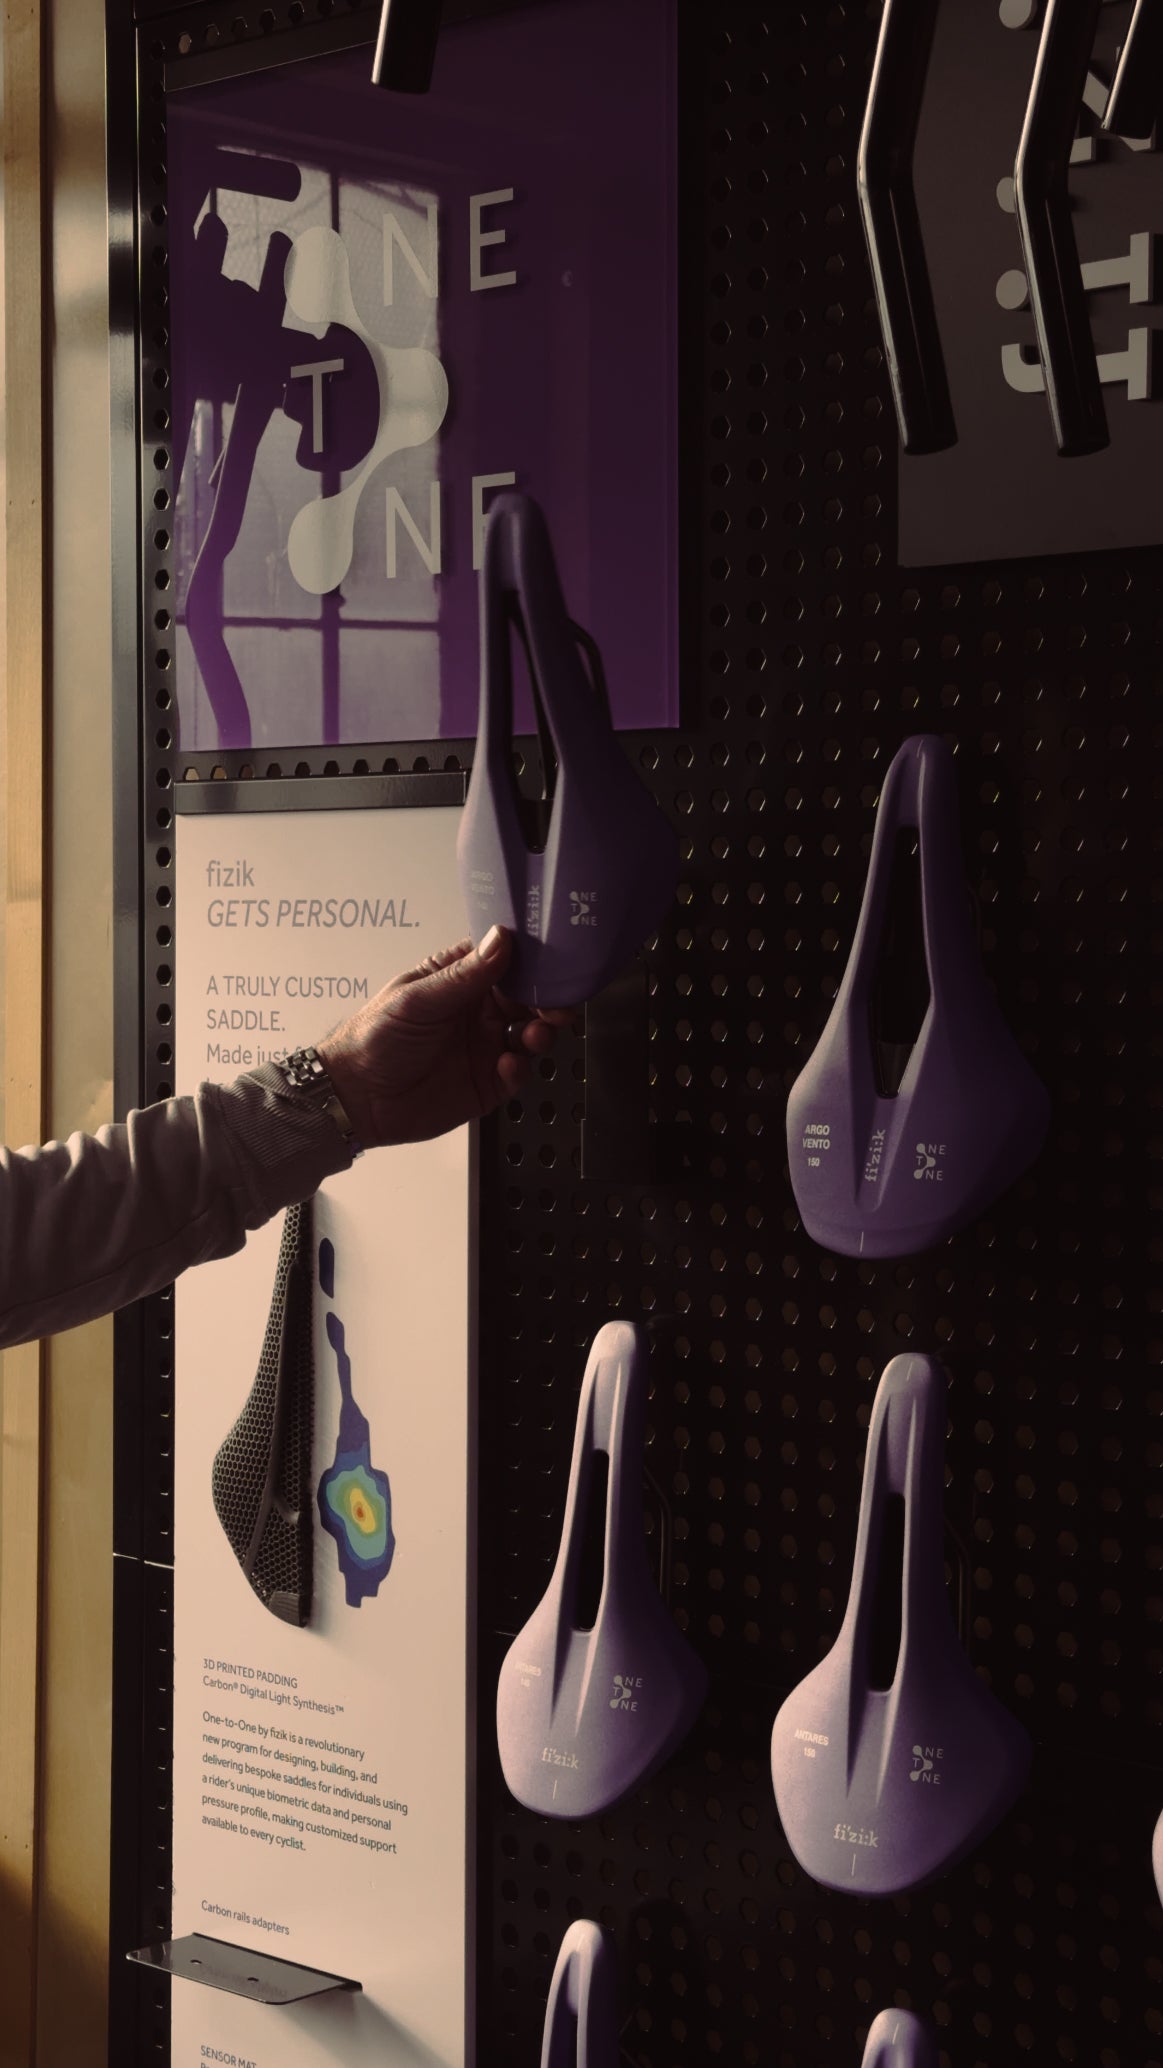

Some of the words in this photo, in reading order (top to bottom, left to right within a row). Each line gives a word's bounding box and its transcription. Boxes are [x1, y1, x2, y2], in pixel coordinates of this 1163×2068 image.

[206, 860, 255, 888] fizik
[207, 898, 270, 928] GETS
[276, 898, 421, 929] PERSONAL.
[206, 975, 219, 996] A
[222, 975, 281, 997] TRULY
[285, 976, 369, 999] CUSTOM
[207, 1008, 286, 1032] SADDLE.
[207, 1043, 253, 1065] Made
[802, 1138, 831, 1150] VENTO
[805, 1124, 830, 1135] ARGO
[203, 1658, 215, 1670] 3D
[216, 1661, 255, 1679] PRINTED
[256, 1670, 298, 1689] PADDING
[240, 1684, 268, 1701] Digital
[269, 1692, 291, 1706] Light
[202, 1711, 257, 1734] One-to-One
[258, 1723, 268, 1738] by
[270, 1726, 288, 1742] fizik
[289, 1733, 297, 1743] is
[298, 1735, 304, 1744] a
[305, 1737, 365, 1761] revolutionary
[794, 1729, 829, 1746] ANTARES
[202, 1734, 220, 1745] new
[221, 1738, 258, 1755] program
[259, 1745, 272, 1758] for
[273, 1749, 319, 1771] designing,
[320, 1760, 359, 1781] building,
[360, 1771, 378, 1784] and
[202, 1753, 243, 1774] delivering
[244, 1762, 282, 1781] bespoke
[283, 1774, 317, 1790] saddles
[318, 1781, 331, 1794] for
[333, 1784, 381, 1807] individuals
[383, 1799, 408, 1816] using
[202, 1774, 208, 1784] a
[236, 1783, 266, 1799] unique
[267, 1789, 310, 1809] biometric
[311, 1801, 332, 1815] data
[333, 1806, 350, 1820] and
[351, 1812, 392, 1831] personal
[202, 1794, 239, 1812] pressure
[240, 1803, 271, 1822] profile,
[272, 1812, 304, 1831] making
[305, 1821, 358, 1843] customized
[360, 1836, 397, 1854] support
[202, 1814, 238, 1832] available
[239, 1823, 249, 1835] to
[250, 1827, 275, 1845] every
[276, 1834, 307, 1851] cyclist.
[201, 1900, 232, 1918] Carbon
[233, 1911, 251, 1923] rails
[252, 1917, 290, 1935] adapters
[200, 2045, 237, 2067] SENSOR
[238, 2057, 257, 2068] MAT
